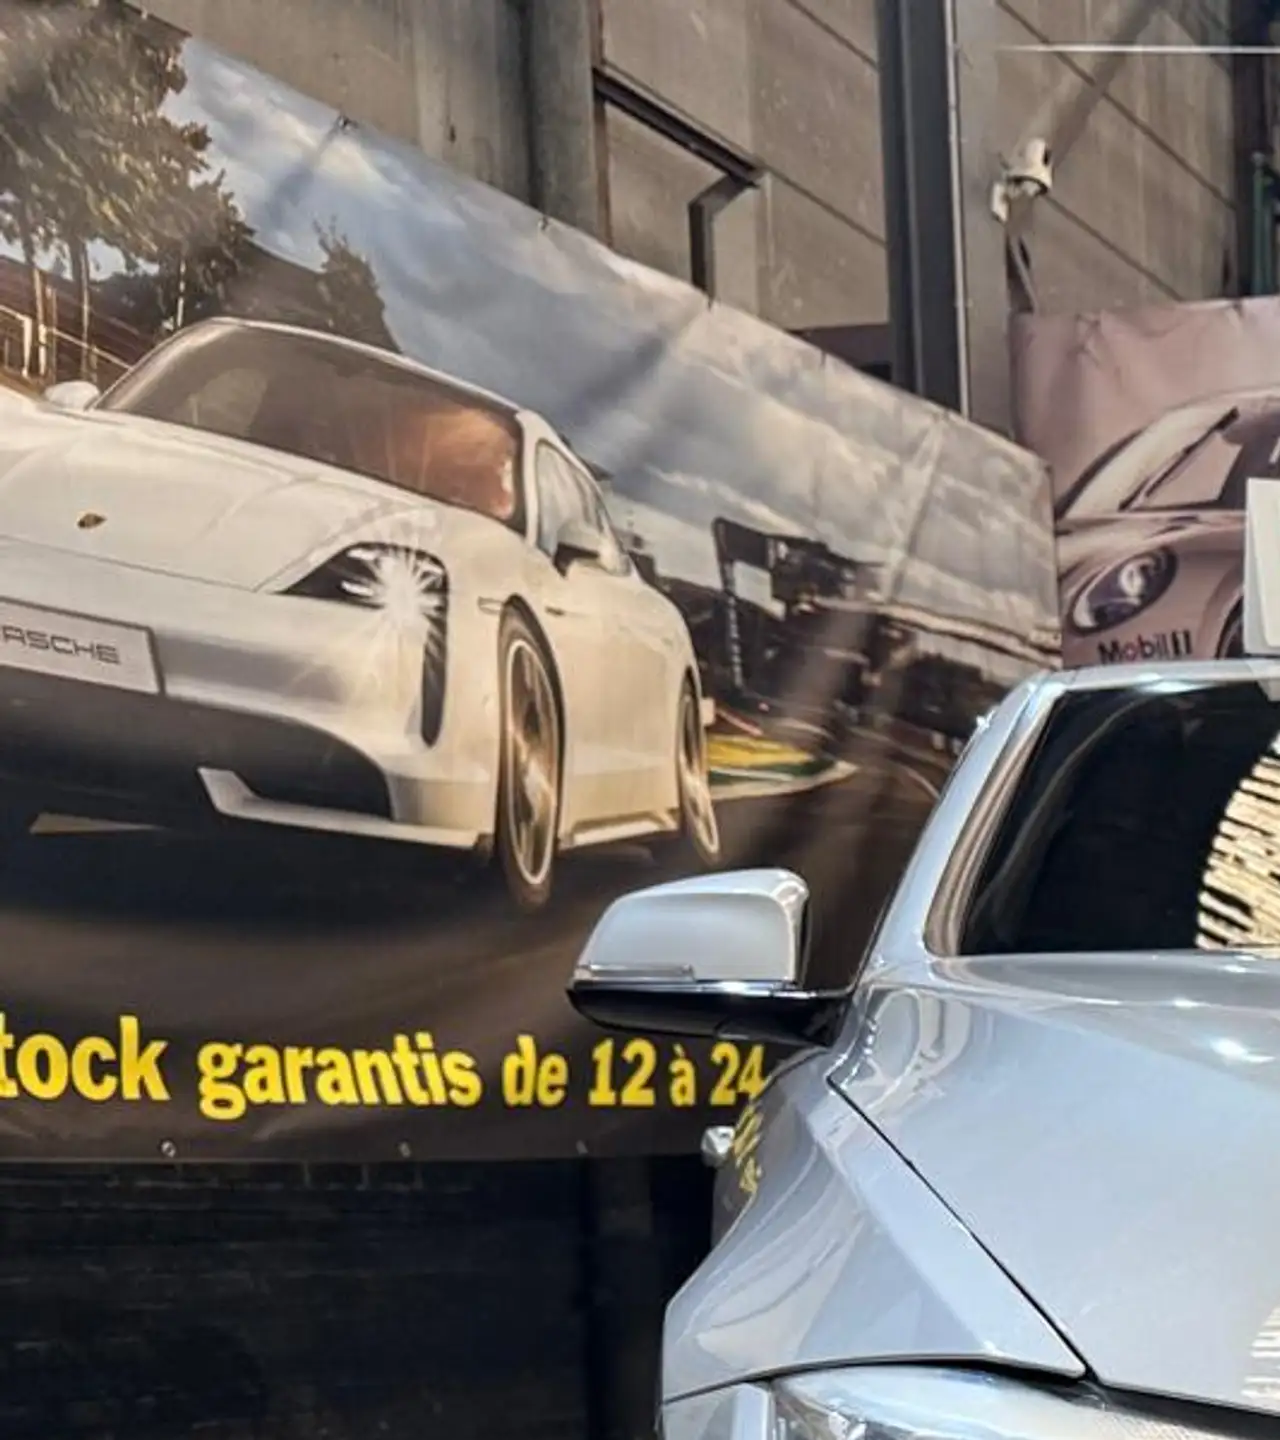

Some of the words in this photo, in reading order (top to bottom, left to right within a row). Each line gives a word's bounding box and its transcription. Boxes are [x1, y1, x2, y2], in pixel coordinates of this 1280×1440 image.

[198, 1031, 482, 1120] garantis
[502, 1034, 568, 1107] de
[590, 1038, 656, 1106] 12
[670, 1044, 697, 1106] à
[708, 1041, 768, 1105] 24
